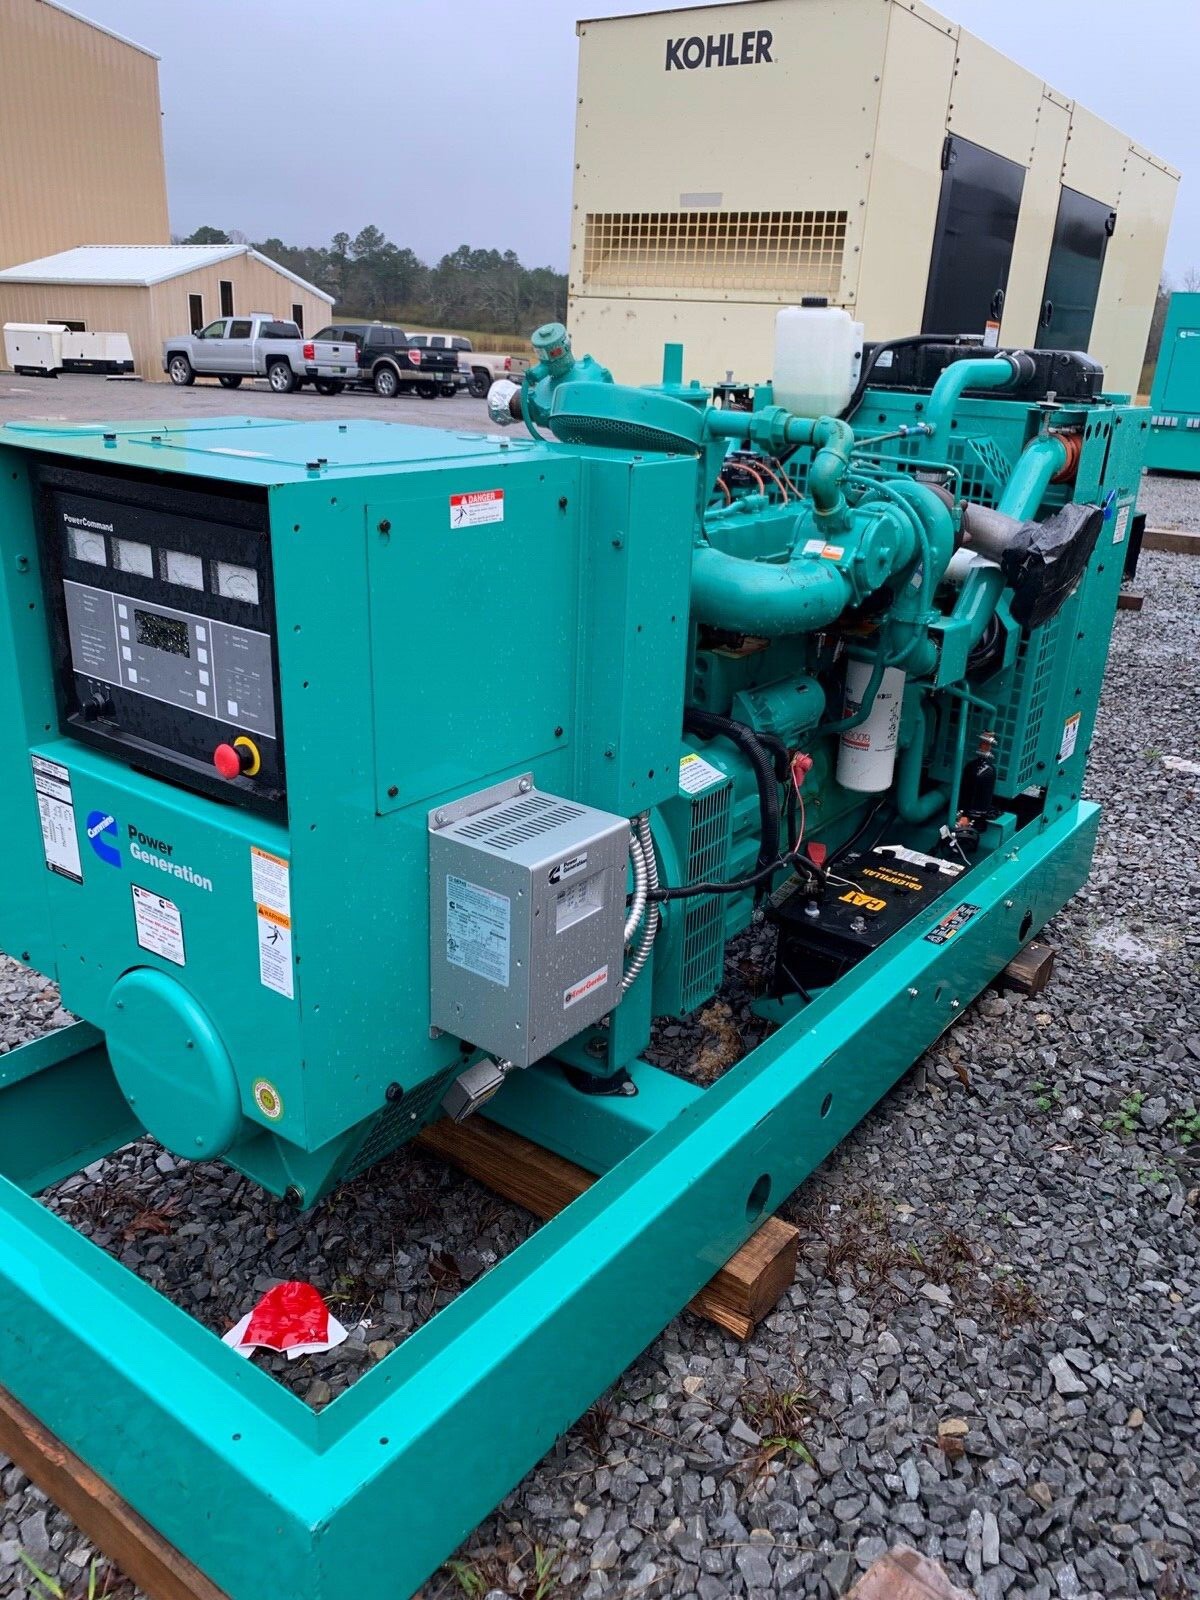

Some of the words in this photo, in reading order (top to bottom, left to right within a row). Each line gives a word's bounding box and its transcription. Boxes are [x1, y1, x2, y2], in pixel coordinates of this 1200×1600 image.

[665, 30, 773, 71] KOHLER
[468, 492, 495, 504] DANGER
[63, 513, 113, 532] PowerCommand
[87, 815, 115, 838] Cummins
[128, 824, 173, 856] Power
[130, 842, 213, 892] Generation
[563, 858, 578, 867] Power
[563, 858, 588, 873] Generation
[862, 868, 922, 891] CATERPILLAR
[838, 890, 887, 911] CAT
[264, 909, 289, 926] WARNING
[570, 972, 607, 998] EnerGenius
